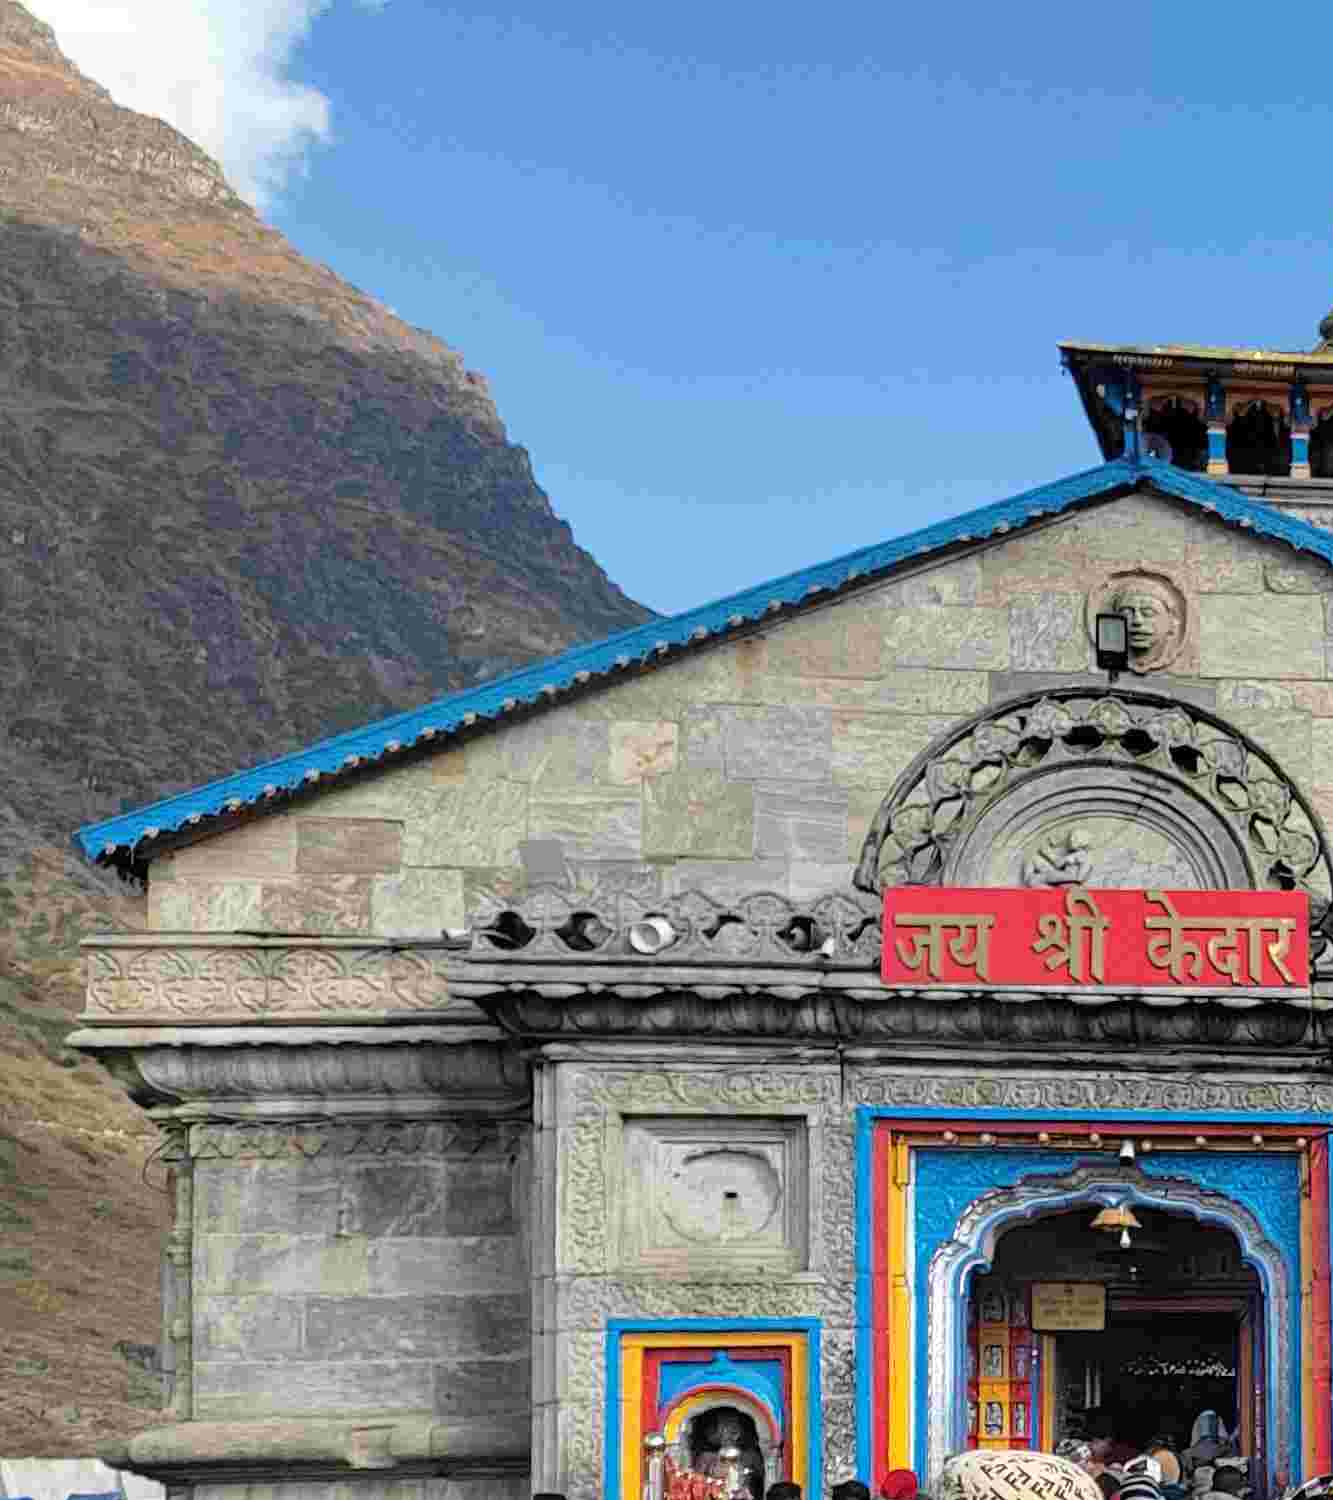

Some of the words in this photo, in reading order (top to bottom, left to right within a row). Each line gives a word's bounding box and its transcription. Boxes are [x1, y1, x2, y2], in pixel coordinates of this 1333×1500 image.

[895, 914, 994, 982] जय
[1031, 886, 1109, 984] श्री
[1145, 888, 1296, 985] केदार
